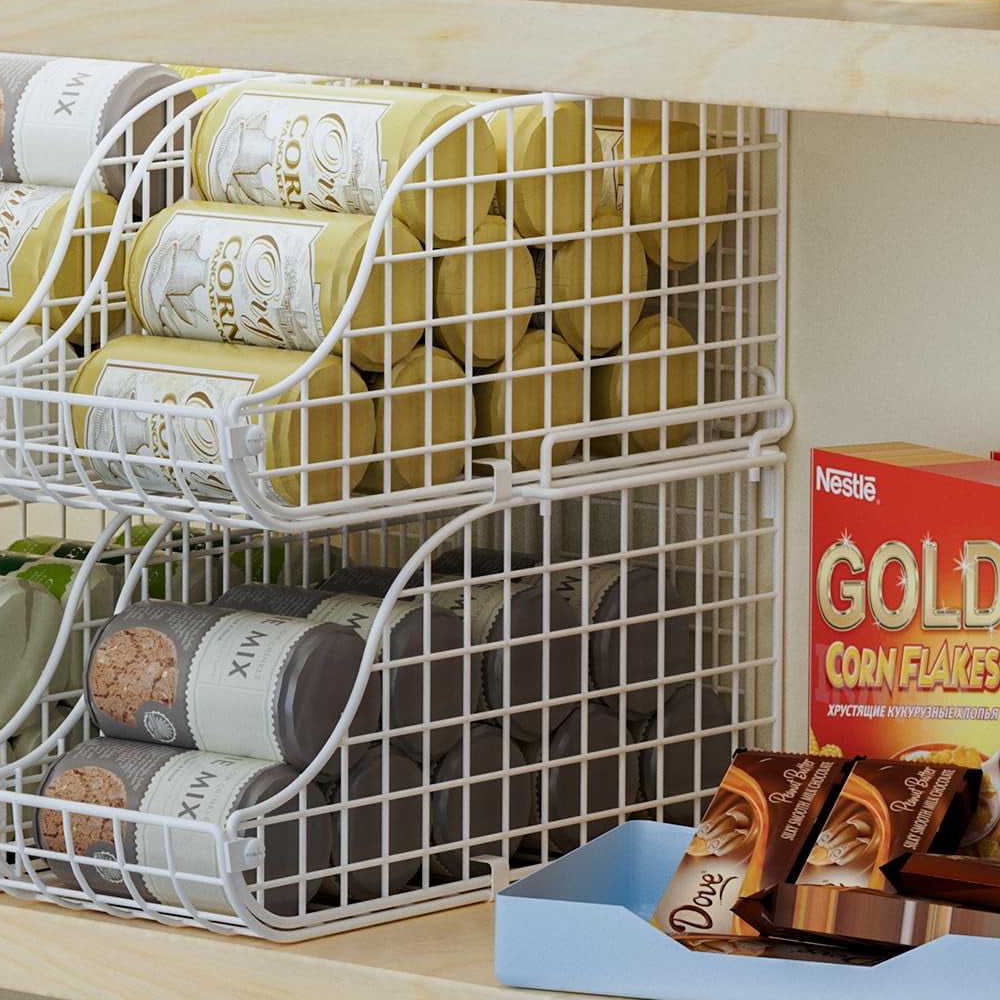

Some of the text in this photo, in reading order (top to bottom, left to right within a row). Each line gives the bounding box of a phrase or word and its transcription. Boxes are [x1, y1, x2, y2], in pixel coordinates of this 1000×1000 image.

[54, 71, 92, 117] MIX
[816, 540, 1000, 631] GOLD
[228, 629, 268, 679] MIX
[825, 640, 1000, 693] CORN FLAKES
[827, 703, 1000, 720] ХРУСТЯЩИЕ КУКУРУЗНЫЕ ХЛОПЬЯ
[177, 771, 218, 820] MIX
[768, 758, 815, 804] Peanut Butter
[780, 761, 834, 841] SILKY SMOOTH MILK CHOCOLATE
[890, 766, 936, 812] Peanut Butter
[903, 769, 956, 850] SILKY SMOOTH MILK CHOCOLATE
[669, 872, 722, 933] Dove
